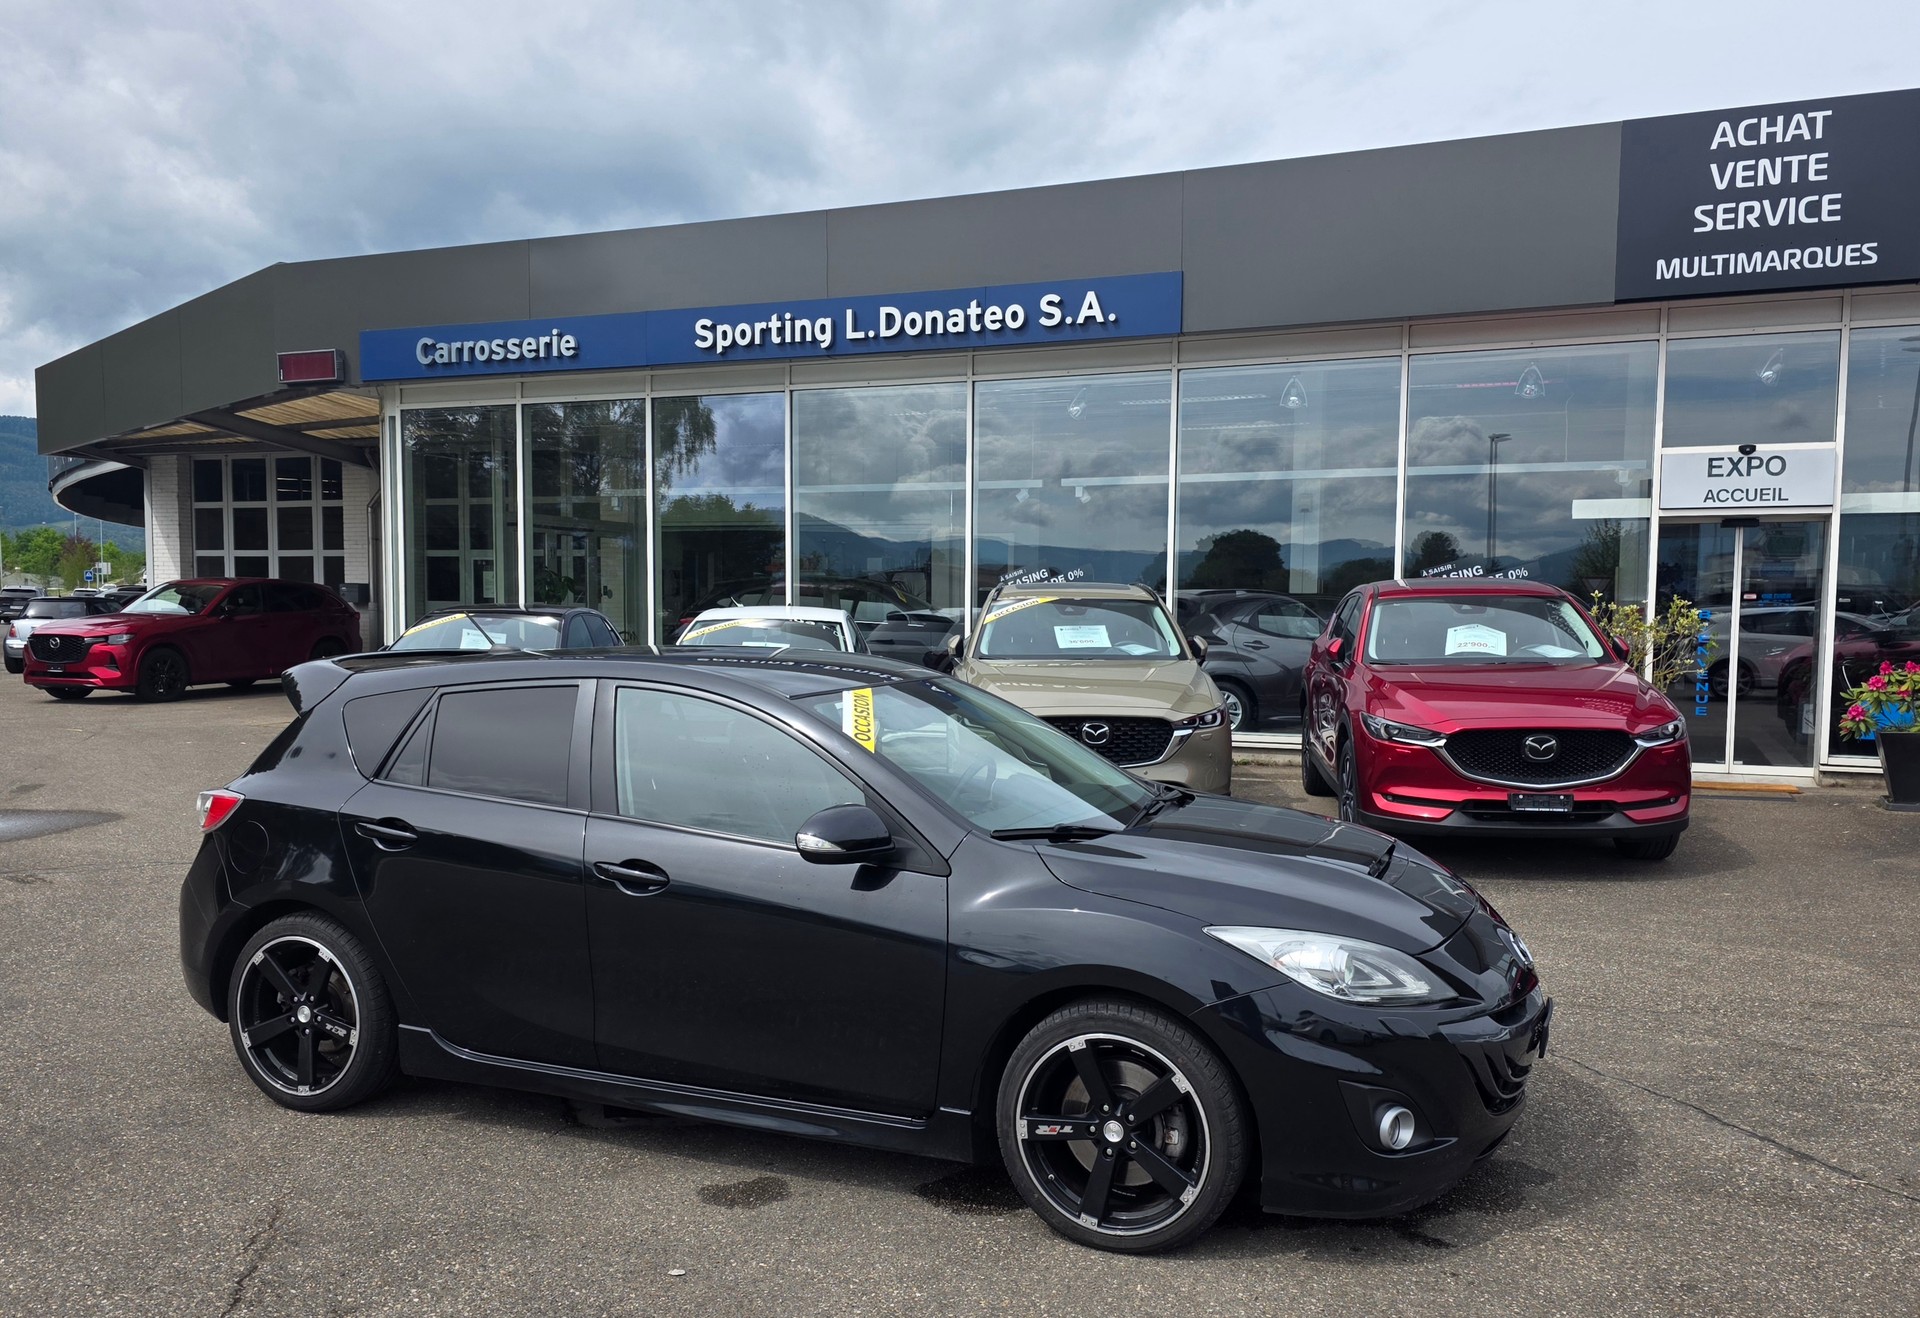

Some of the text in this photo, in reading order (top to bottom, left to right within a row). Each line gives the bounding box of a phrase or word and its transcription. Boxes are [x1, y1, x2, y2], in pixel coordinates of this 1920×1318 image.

[1710, 110, 1833, 150] ACHAT
[1710, 152, 1829, 190] VENTE
[1693, 193, 1842, 232] SERVICE
[1656, 242, 1878, 280] MULTIMARQUES
[694, 290, 1117, 354] Sporting L.Donateo S.A.
[415, 328, 577, 365] Carrosserie
[1707, 455, 1787, 478] EXPO
[1703, 487, 1789, 503] ACCUEIL
[1005, 569, 1024, 581] SAISIR
[1006, 568, 1049, 586] EASING
[1067, 568, 1084, 581] 0%
[1428, 563, 1452, 575] SAISIR
[1508, 567, 1529, 580] 0%
[994, 599, 1039, 618] OCCASION
[696, 620, 740, 635] OCCASION
[1695, 609, 1712, 716] BENVENUE
[853, 692, 872, 742] OCCASION
